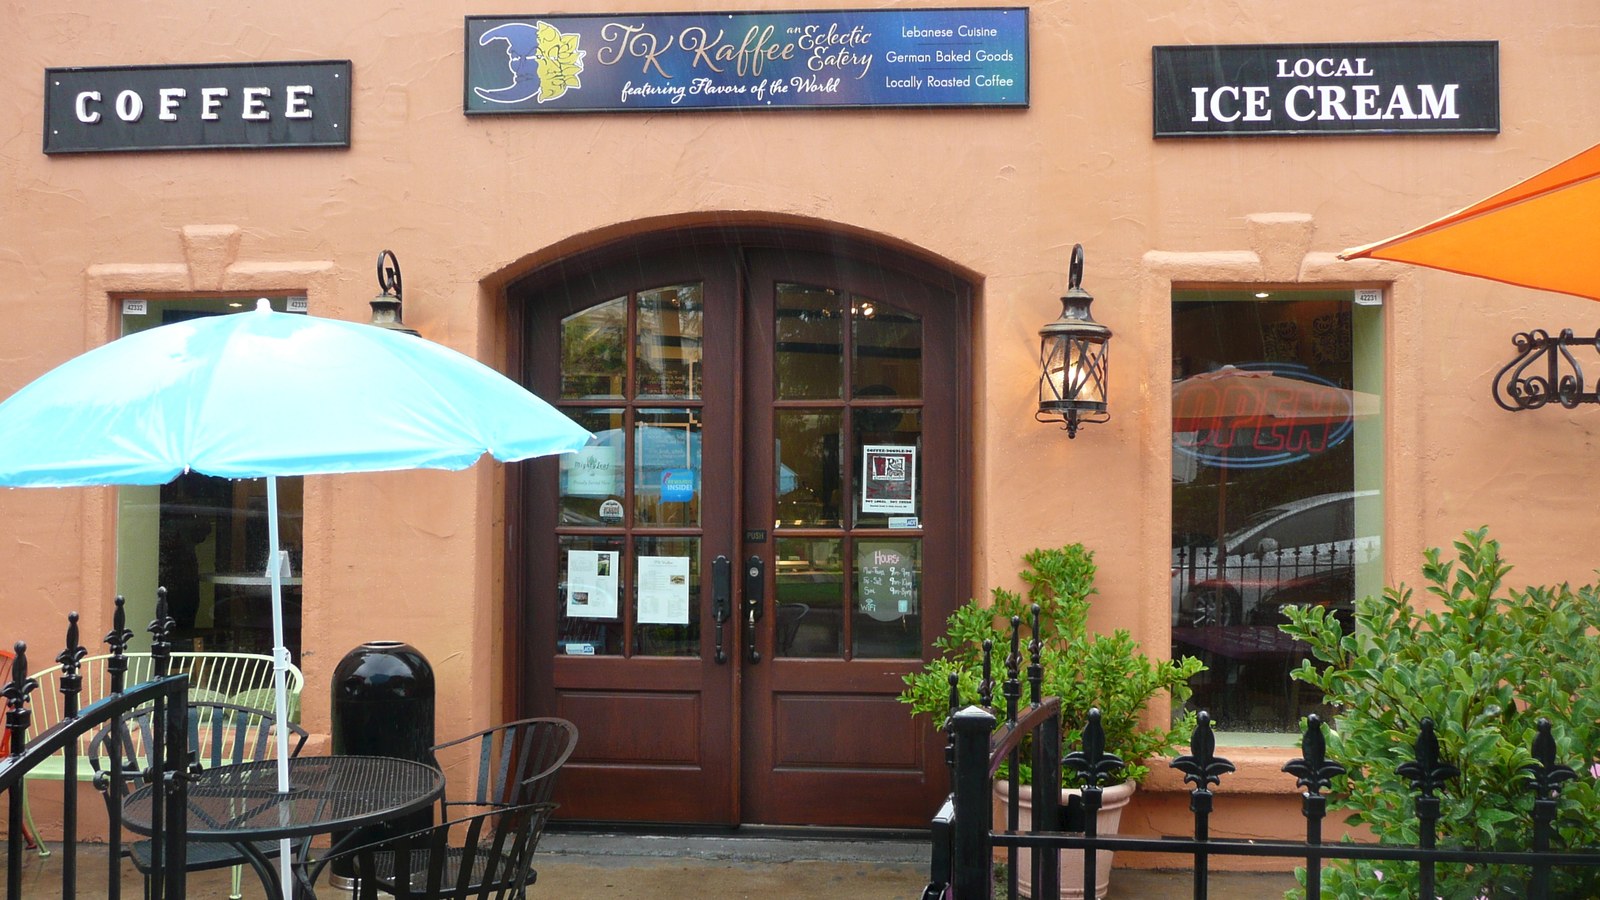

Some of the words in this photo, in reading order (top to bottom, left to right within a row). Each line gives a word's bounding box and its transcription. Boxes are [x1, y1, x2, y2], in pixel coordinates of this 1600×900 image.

[786, 26, 801, 34] an
[798, 22, 872, 50] Eclectic
[902, 26, 954, 38] Lebanese
[958, 25, 998, 37] Cuisine
[679, 25, 795, 77] Kaffee
[807, 46, 873, 80] Eatery
[885, 51, 931, 63] German
[936, 50, 971, 62] Baked
[975, 49, 1014, 62] Goods
[885, 75, 922, 90] Locally
[927, 75, 971, 87] Roasted
[975, 75, 1014, 87] Coffee
[1276, 58, 1373, 78] LOCAL
[621, 80, 686, 104] featuring
[688, 77, 747, 95] Flavors
[750, 78, 768, 101] of
[769, 78, 789, 96] the
[790, 74, 841, 94] World
[1191, 86, 1272, 122] ICE
[1284, 84, 1460, 122] CREAM
[75, 85, 314, 123] COFFEE
[1174, 385, 1338, 453] OPEN
[747, 531, 764, 540] PUSH
